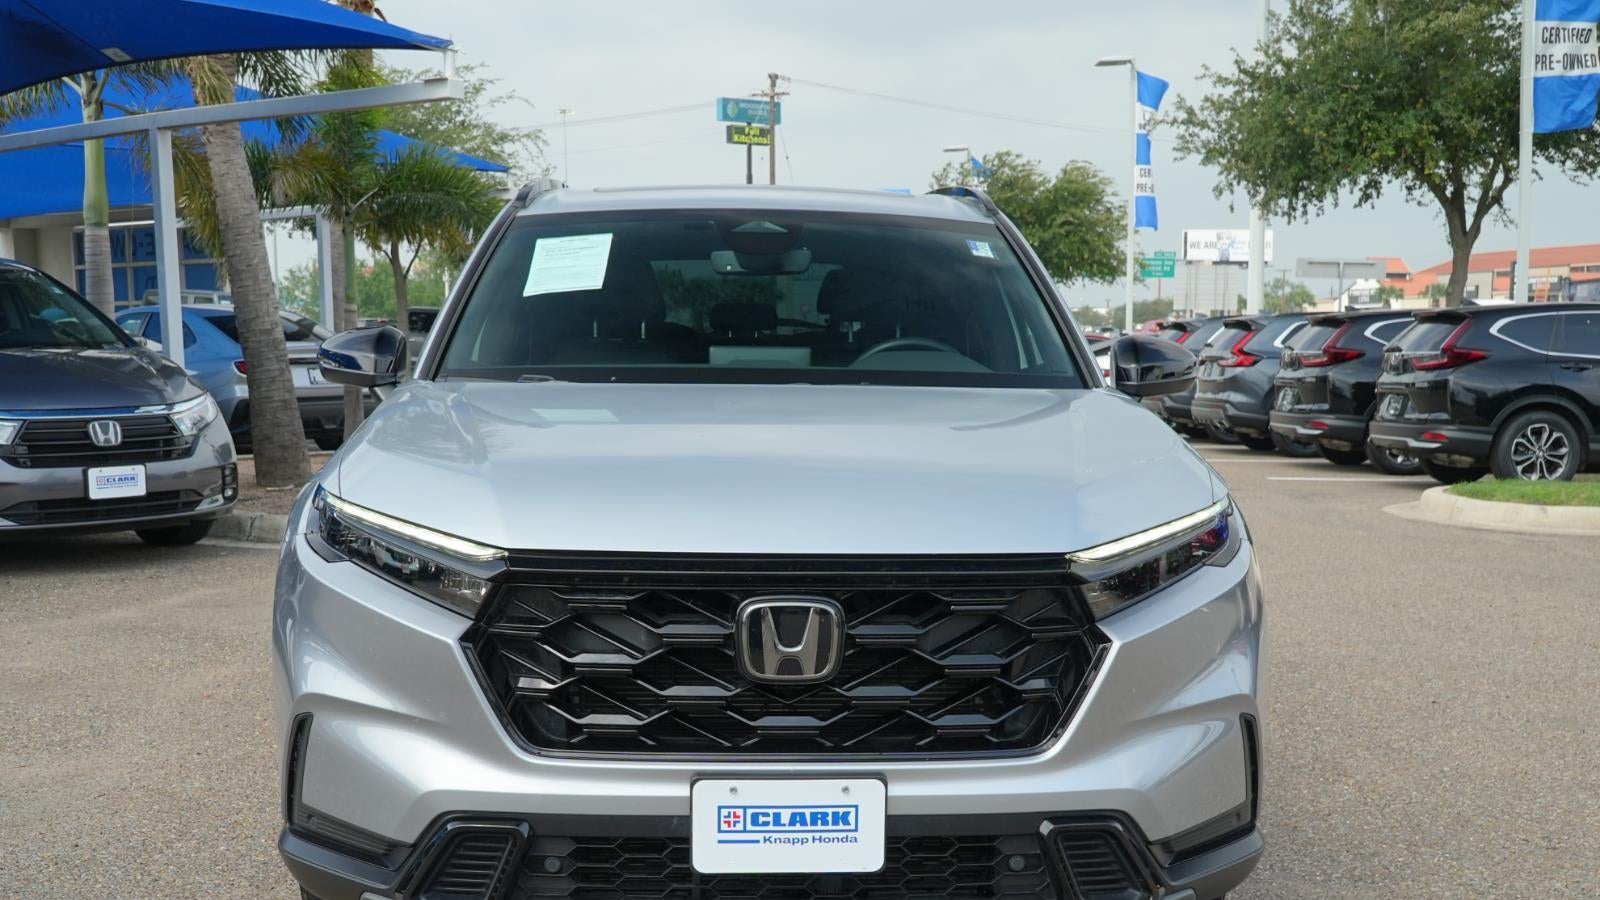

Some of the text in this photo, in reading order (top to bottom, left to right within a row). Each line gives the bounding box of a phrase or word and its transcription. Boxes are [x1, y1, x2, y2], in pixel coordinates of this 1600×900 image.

[1541, 26, 1593, 44] CERTIFIED
[1535, 53, 1597, 71] PRE-OWNED
[1189, 240, 1201, 249] WE
[750, 811, 851, 827] CLARK
[763, 834, 858, 846] Knapp Honda
